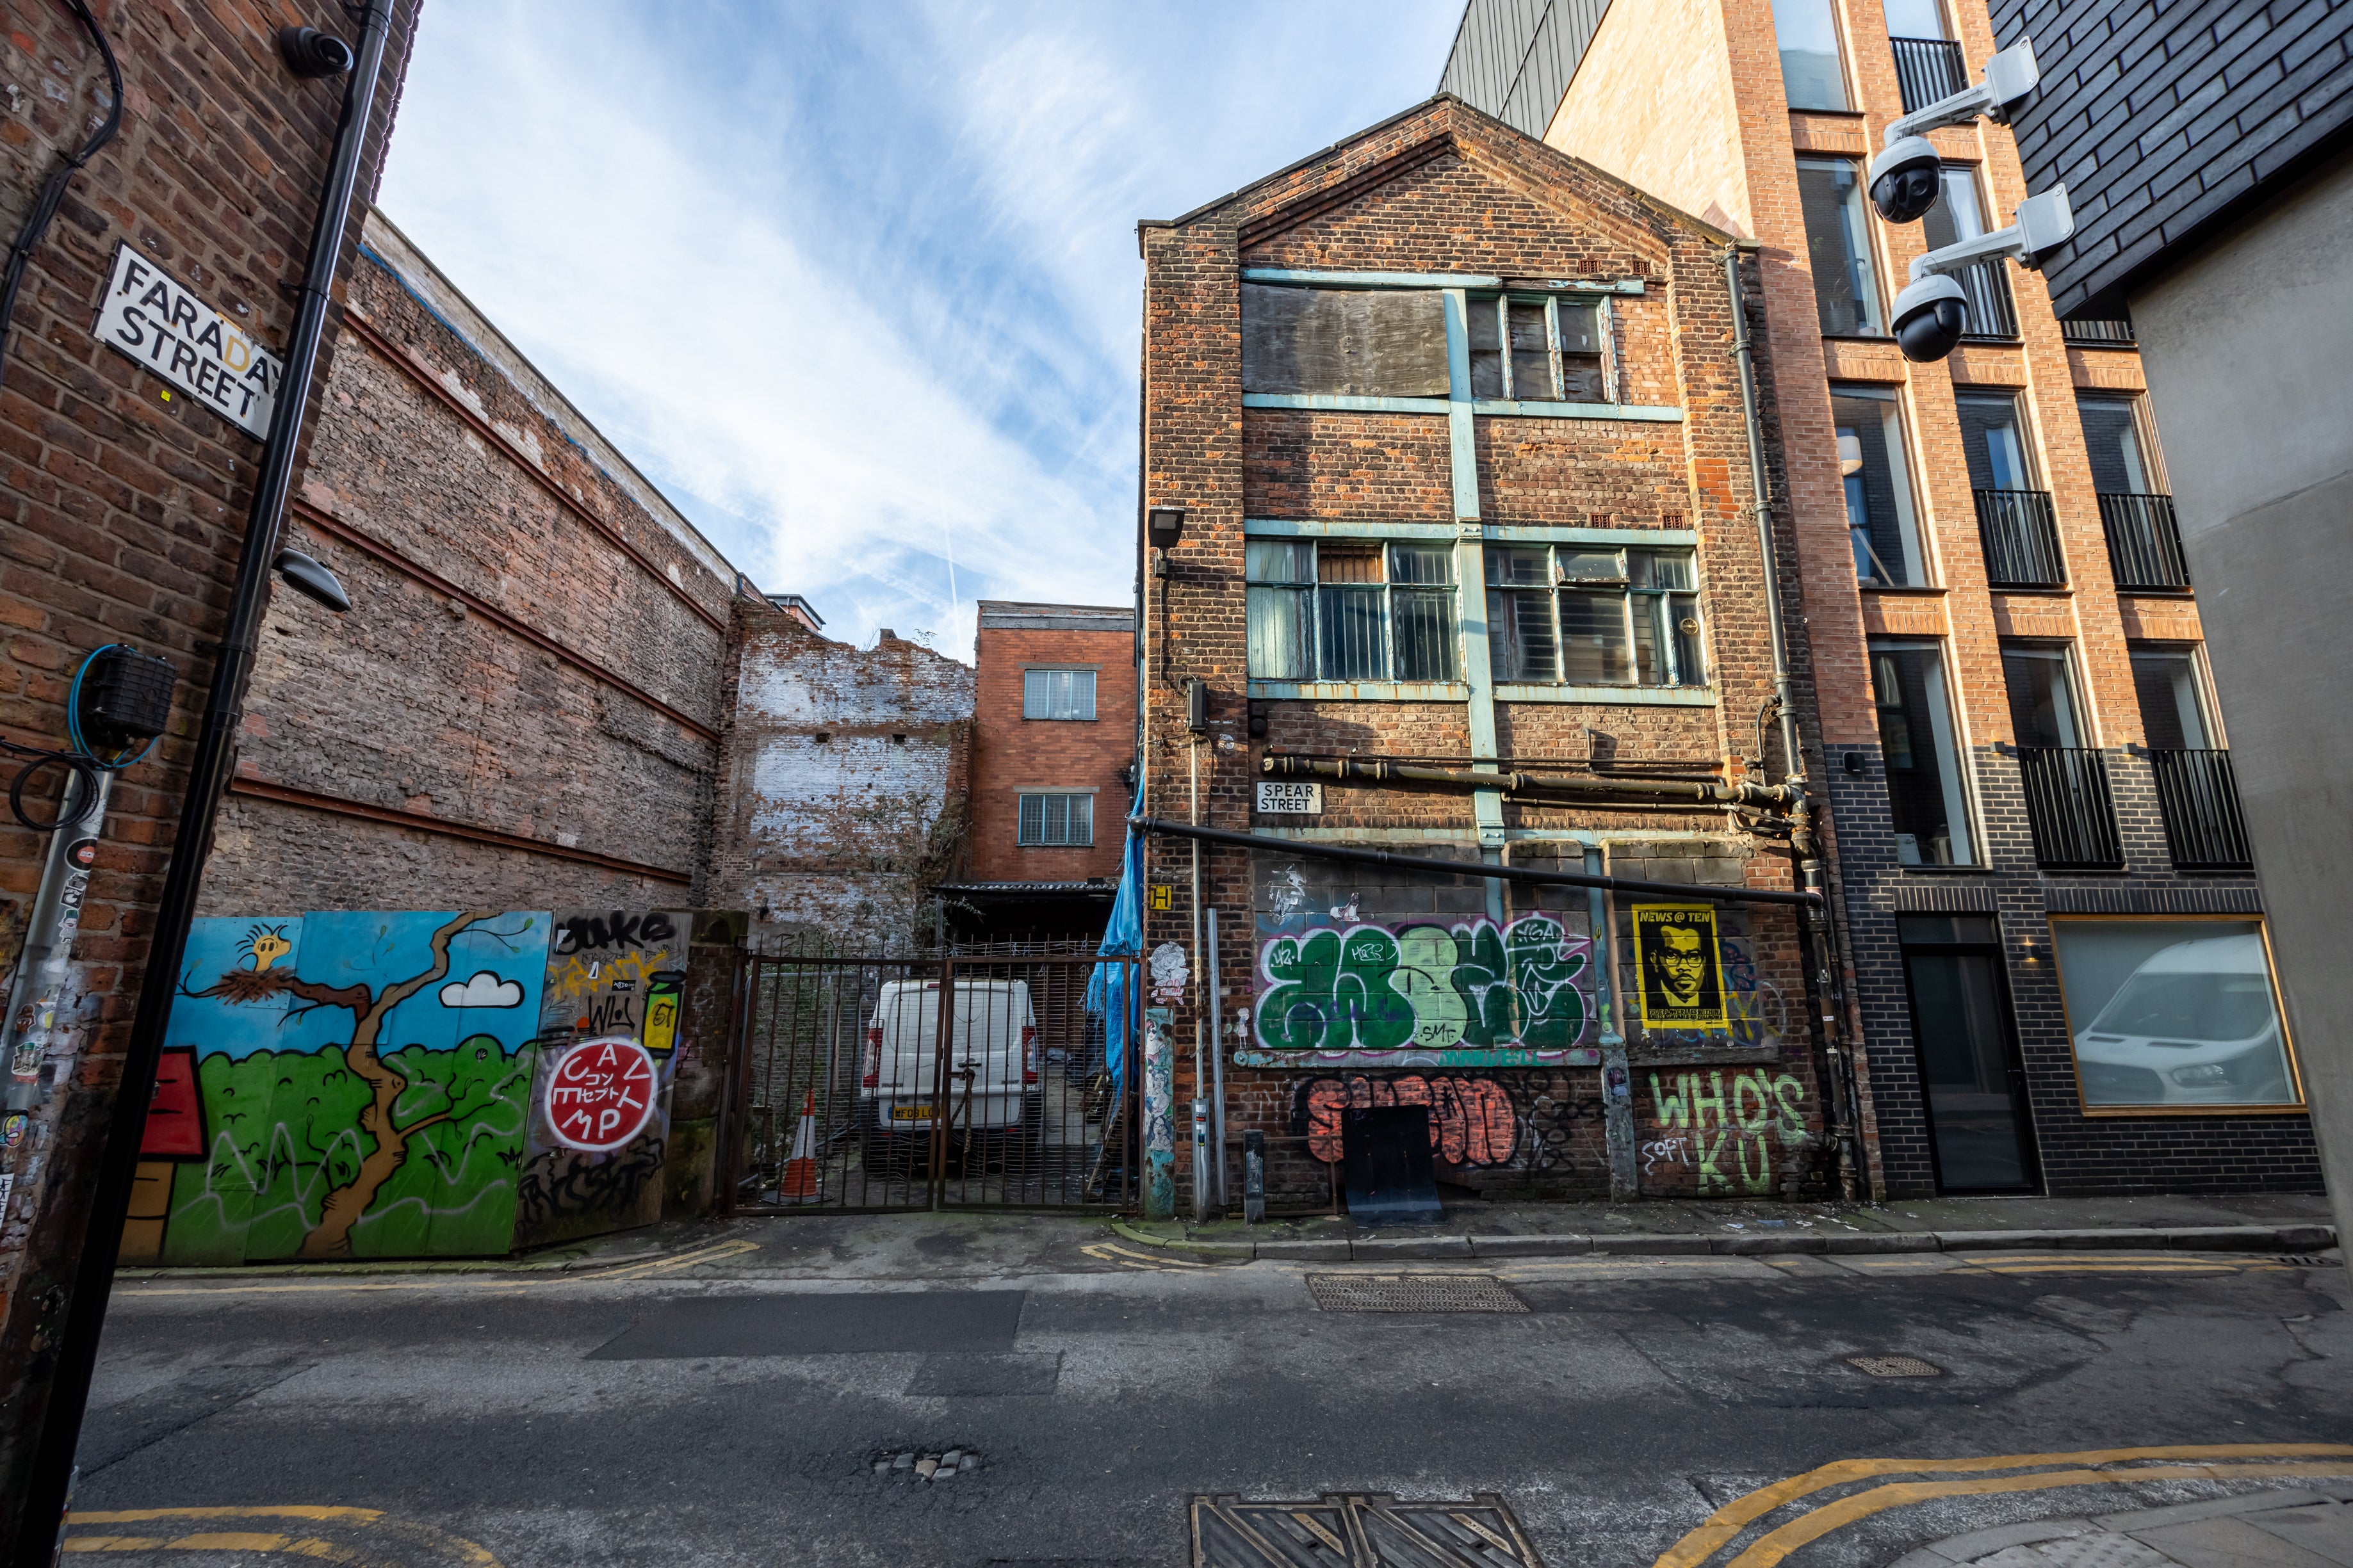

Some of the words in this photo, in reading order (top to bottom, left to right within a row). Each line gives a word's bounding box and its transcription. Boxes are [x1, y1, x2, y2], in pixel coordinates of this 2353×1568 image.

[116, 305, 256, 418] STREET
[1264, 784, 1314, 797] SPEAR
[1261, 798, 1310, 811] STREET
[1640, 912, 1673, 922] NEWS
[1674, 912, 1685, 923] @
[1688, 912, 1711, 922] TEN
